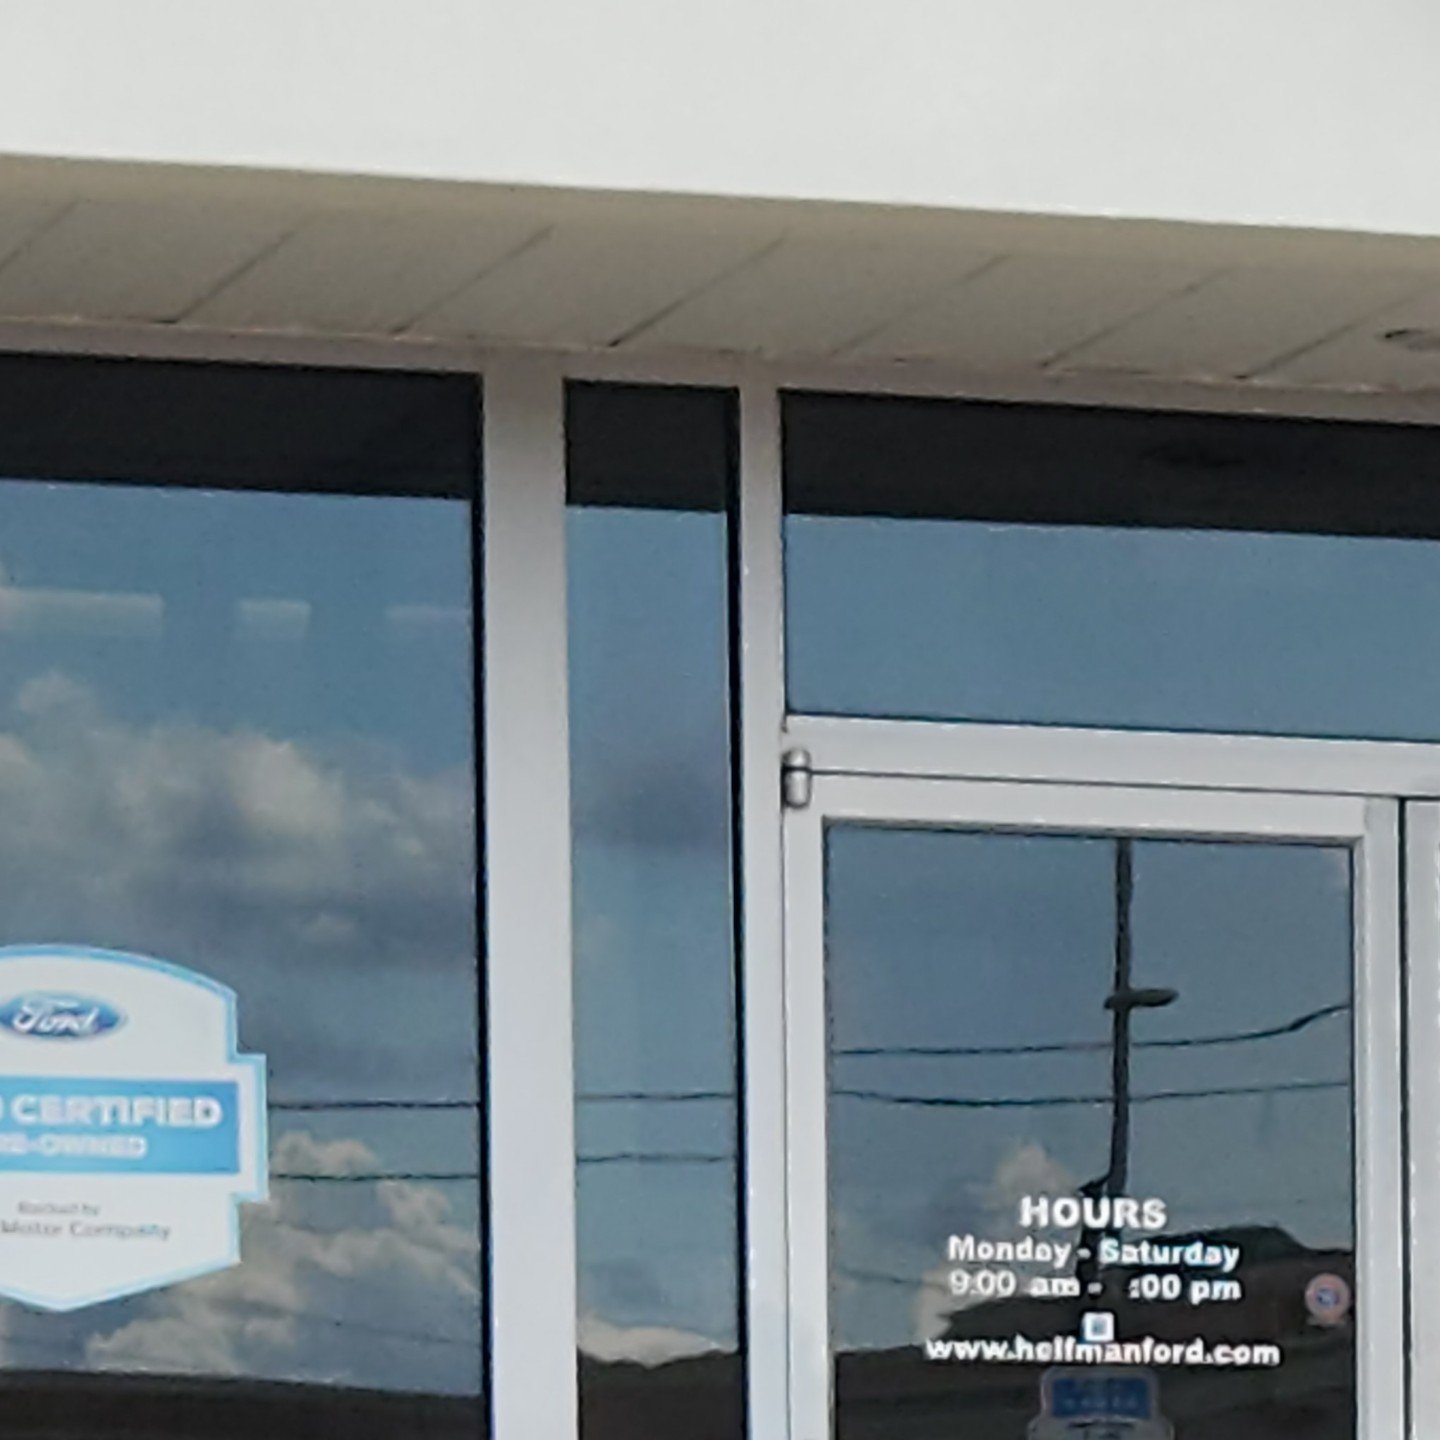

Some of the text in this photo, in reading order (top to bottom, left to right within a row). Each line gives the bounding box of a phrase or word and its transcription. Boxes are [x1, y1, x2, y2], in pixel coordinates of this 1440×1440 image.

[13, 1000, 99, 1034] Ford
[10, 1094, 224, 1128] CERTIFIED
[0, 1132, 148, 1159] RE-OWNED
[1019, 1196, 1168, 1230] HOURS
[948, 1234, 1073, 1268] Monday
[1099, 1238, 1240, 1272] Saturday
[949, 1269, 1017, 1298] 9:00
[1028, 1277, 1081, 1298] am
[1127, 1272, 1182, 1300] :00
[1190, 1279, 1242, 1305] pm
[925, 1334, 1281, 1366] www.helfmanford.com
